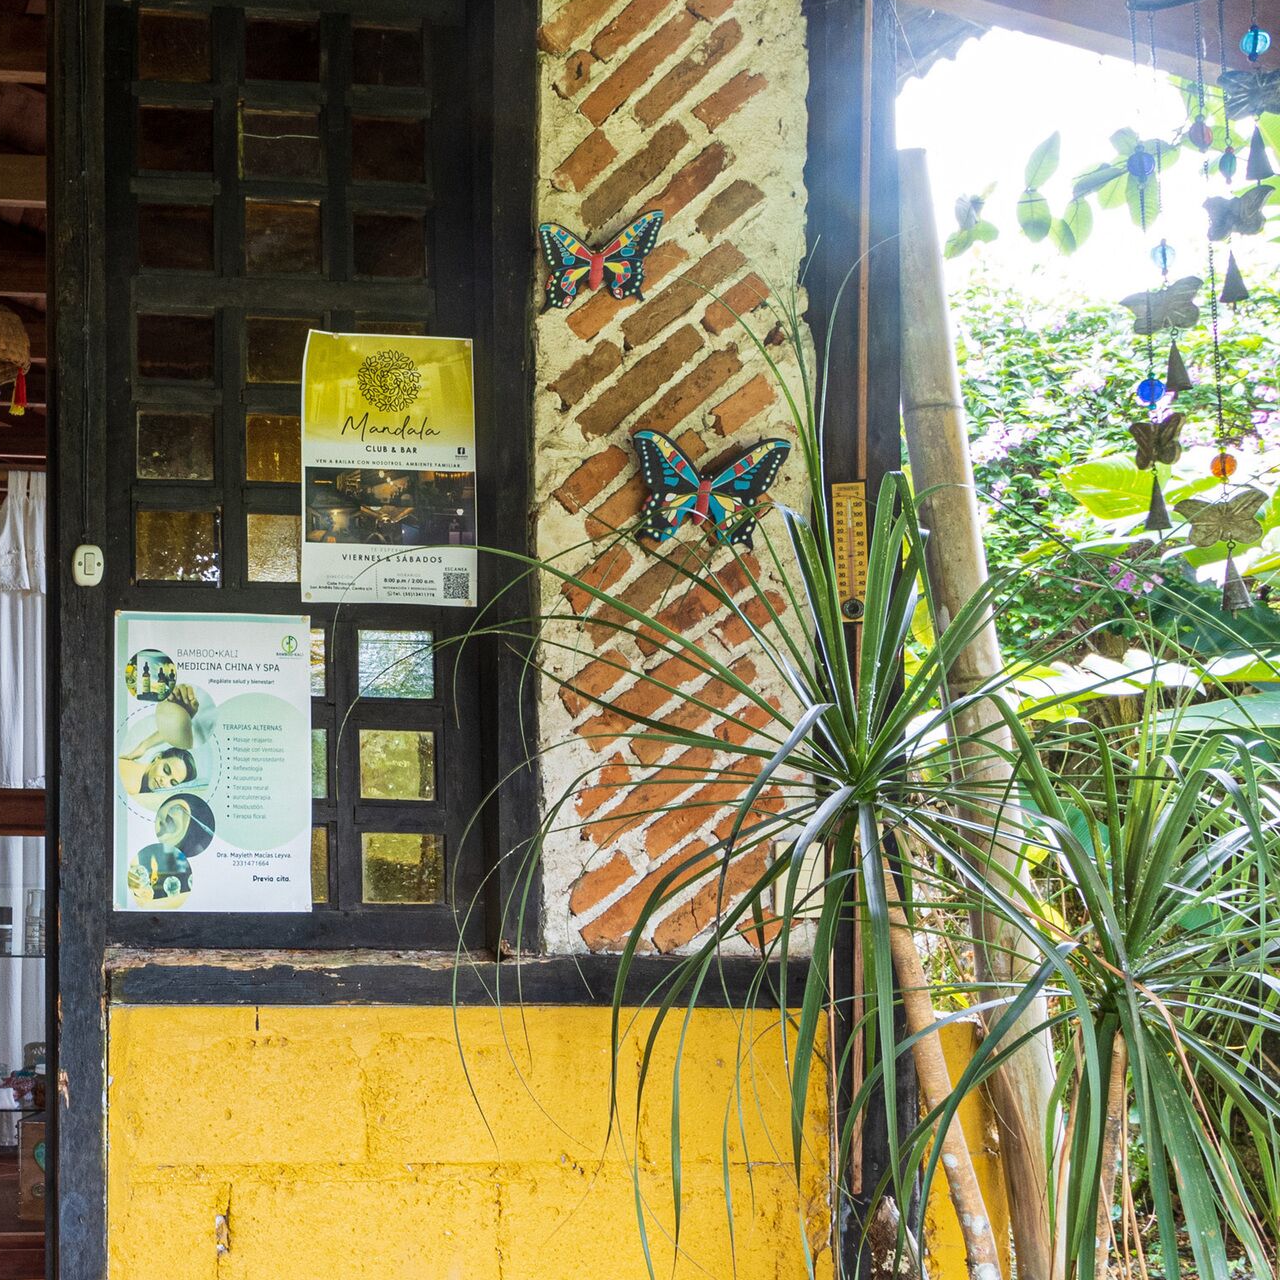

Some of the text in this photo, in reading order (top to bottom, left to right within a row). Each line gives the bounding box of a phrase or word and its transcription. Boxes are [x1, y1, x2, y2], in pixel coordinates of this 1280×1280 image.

[341, 412, 440, 442] Mandala
[366, 445, 388, 453] CLUB
[342, 554, 380, 562] VIERNES
[396, 553, 443, 563] SÁBADOS
[177, 662, 222, 671] MEDICINA
[225, 663, 253, 671] CHINA
[264, 664, 280, 672] SPA
